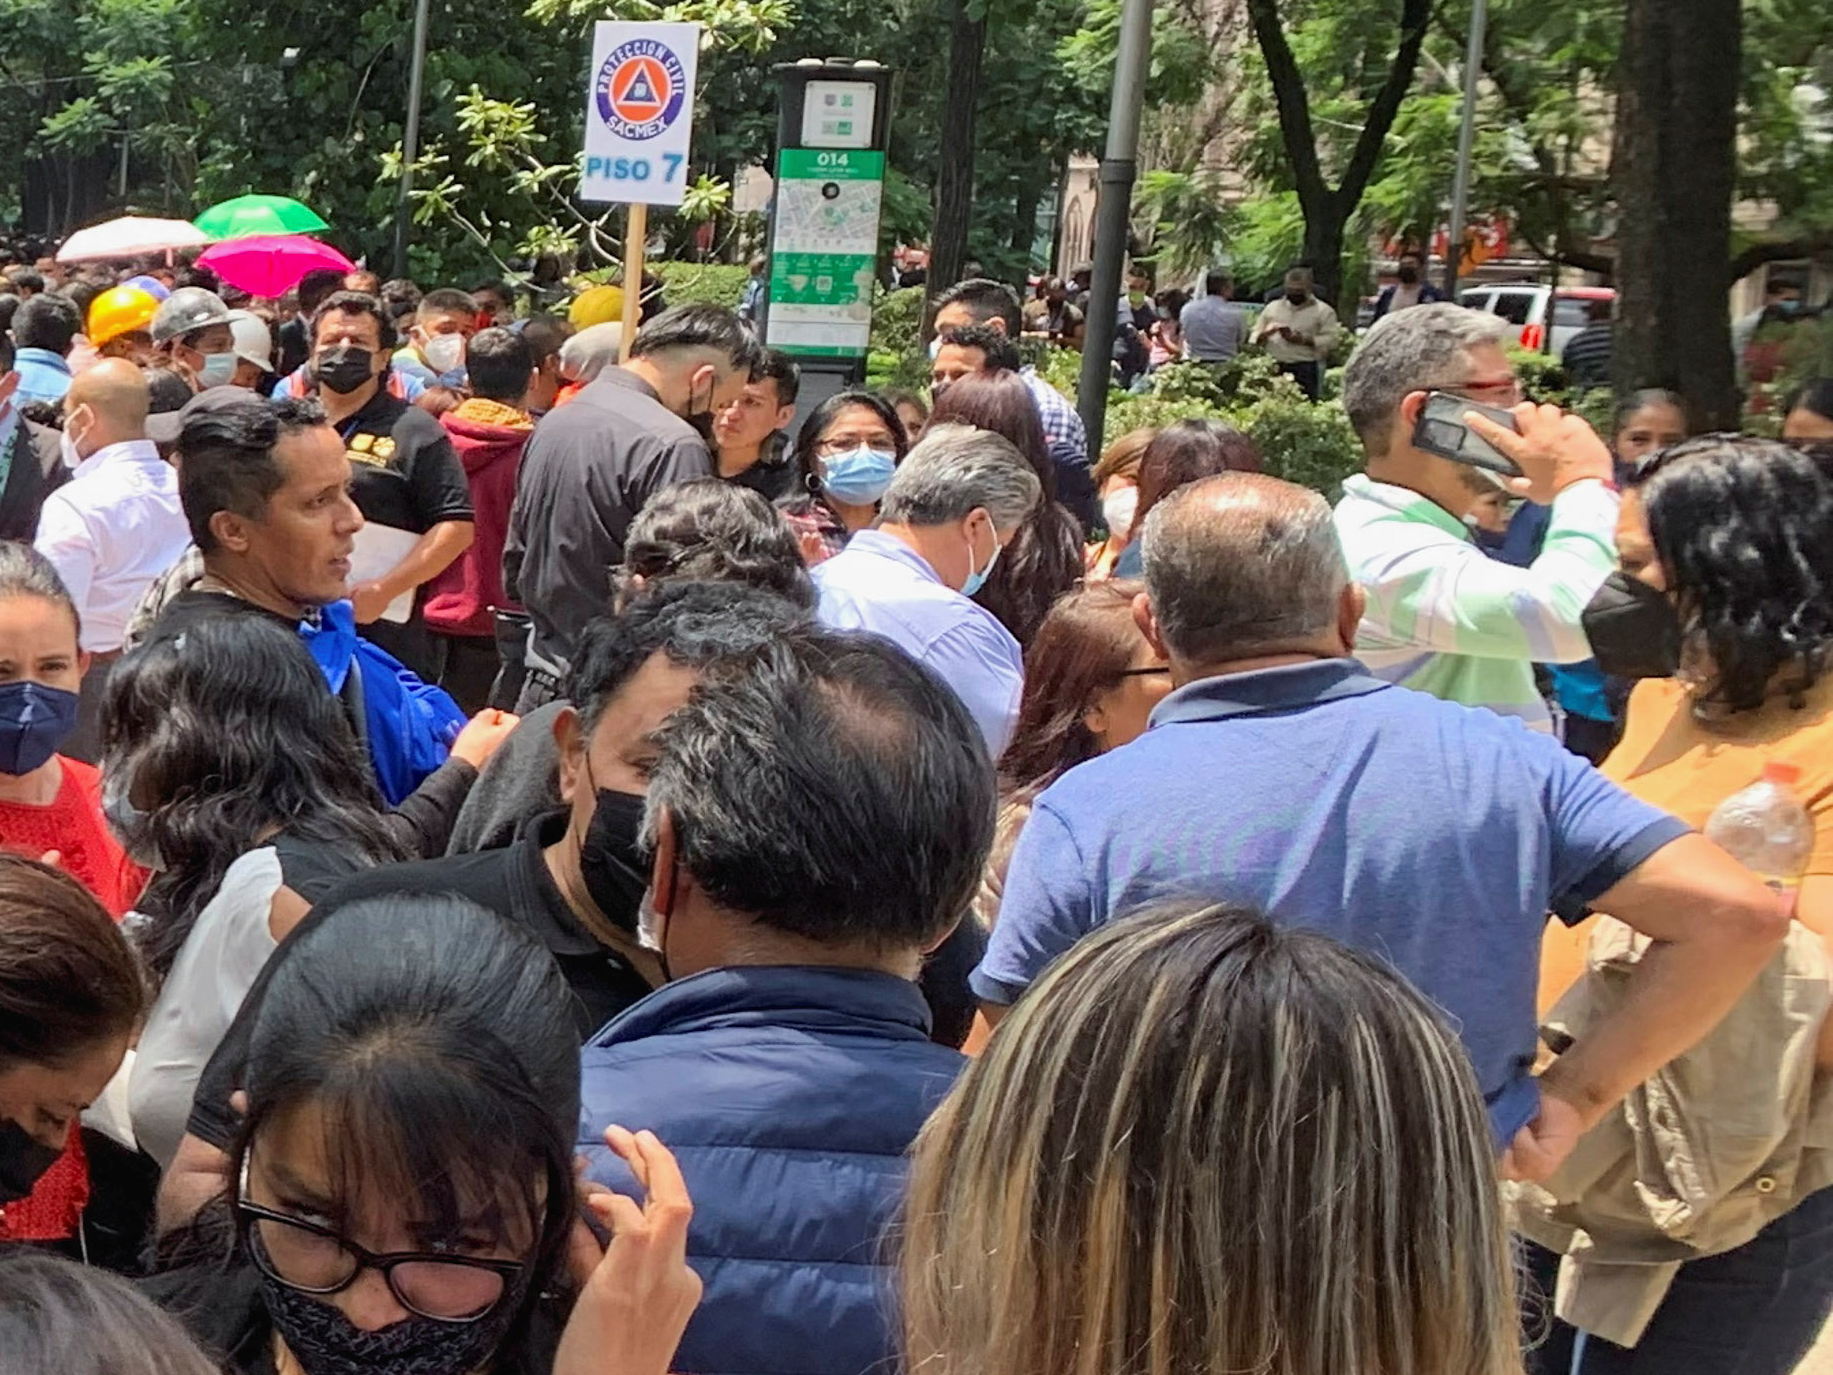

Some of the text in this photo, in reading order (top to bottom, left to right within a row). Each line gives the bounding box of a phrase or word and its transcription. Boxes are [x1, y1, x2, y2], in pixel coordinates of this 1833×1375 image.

[665, 56, 684, 95] CIVIL
[605, 116, 669, 138] SACMEX
[586, 152, 684, 183] PISO 7
[817, 152, 850, 166] 014
